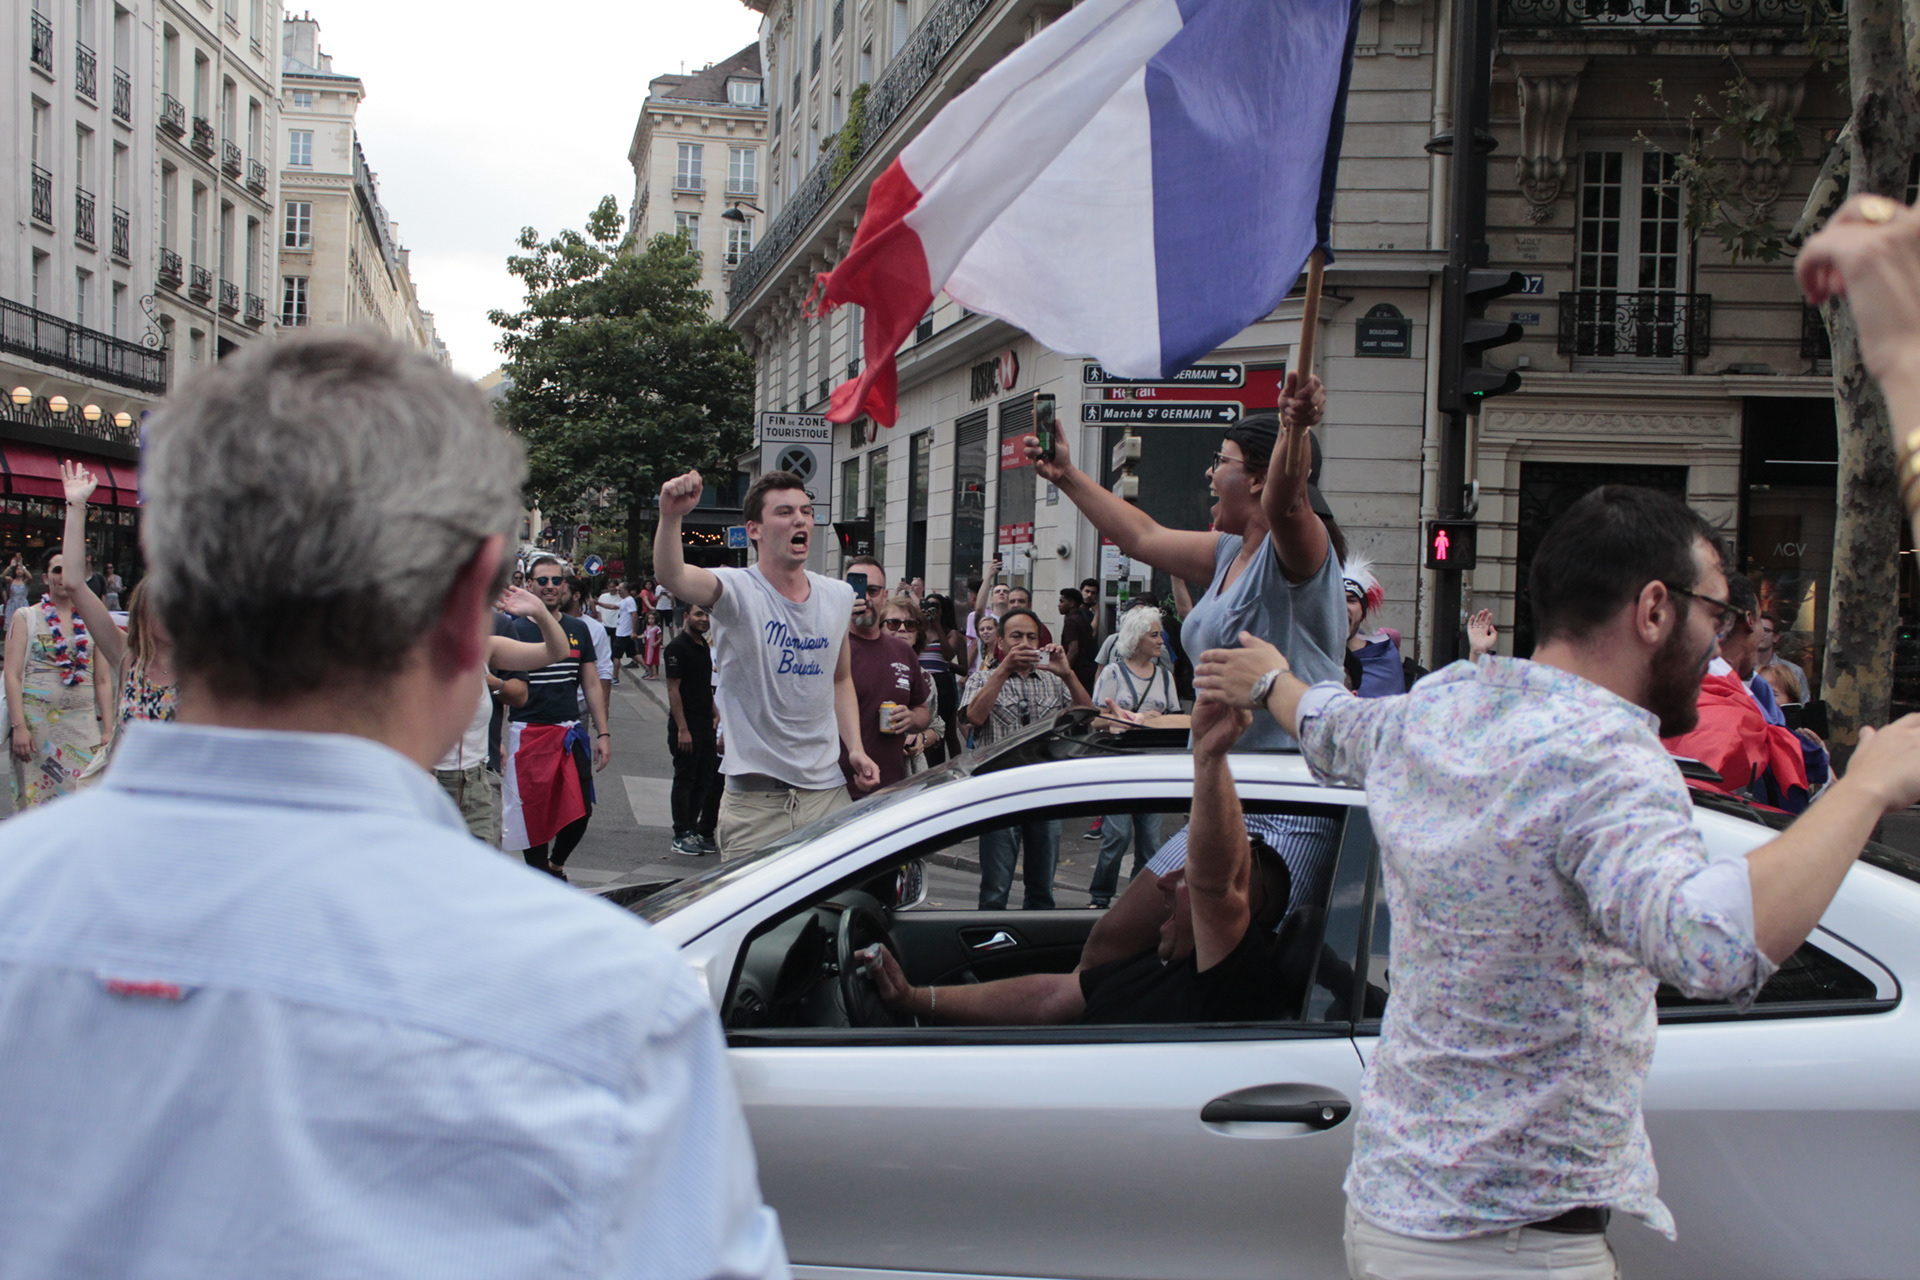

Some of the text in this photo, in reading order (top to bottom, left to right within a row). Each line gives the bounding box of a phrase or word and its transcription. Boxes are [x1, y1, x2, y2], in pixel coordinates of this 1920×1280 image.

[1112, 387, 1156, 399] Rerait
[1103, 408, 1143, 419] Marché
[1161, 408, 1213, 419] GERMAIN
[768, 416, 786, 426] FIN
[798, 417, 826, 427] ZONE
[766, 428, 829, 439] TOURISTIQUE
[765, 620, 829, 650] Monsieur
